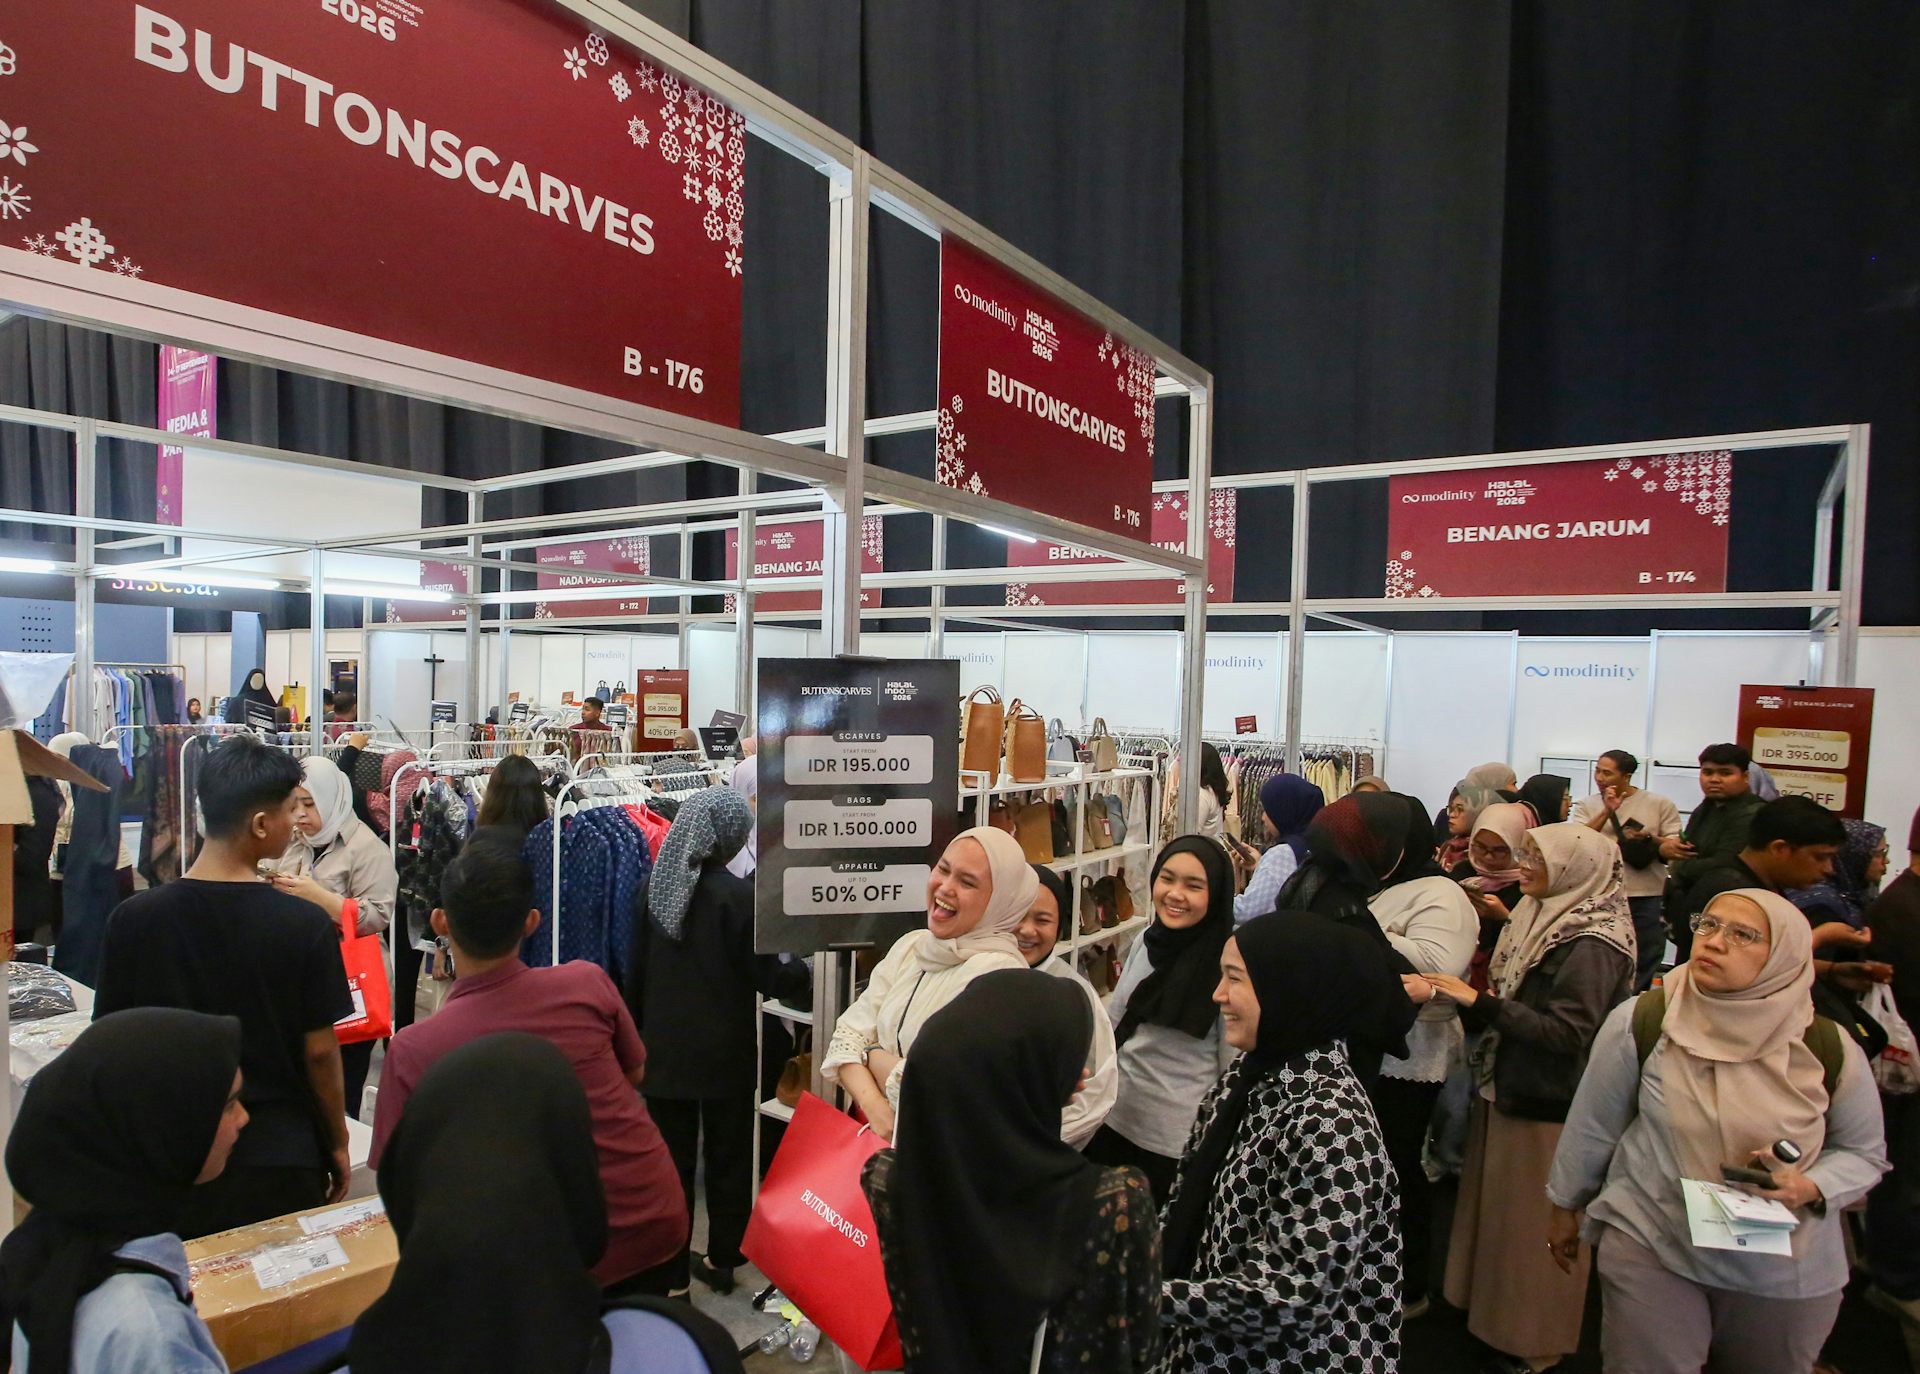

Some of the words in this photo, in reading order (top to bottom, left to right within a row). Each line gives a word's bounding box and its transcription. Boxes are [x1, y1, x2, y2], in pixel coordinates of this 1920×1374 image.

[321, 0, 397, 41] 2026
[403, 15, 419, 28] Expo
[134, 4, 656, 256] BUTTONSCARVES
[972, 294, 1018, 332] modinity
[1032, 341, 1053, 362] 2026
[623, 346, 645, 377] B
[665, 358, 705, 394] 176
[987, 368, 1126, 452] BUTTONSCARVES
[166, 411, 198, 433] MEDIA
[198, 408, 206, 426] &
[1421, 490, 1477, 501] modinity
[1497, 496, 1526, 506] 2026
[1114, 504, 1122, 522] B
[1126, 507, 1140, 527] 176
[1447, 523, 1550, 543] BENANG
[1555, 518, 1650, 539] JARUM
[754, 562, 803, 576] BENANG
[1638, 571, 1652, 583] B
[1666, 570, 1697, 583] 174
[559, 575, 584, 586] NADA
[1205, 656, 1265, 671] modinity
[1554, 663, 1638, 681] modinity
[801, 686, 872, 696] BUTTONSCARVES
[663, 729, 678, 737] OFF
[839, 732, 881, 740] SCARVES
[1761, 748, 1784, 758] IDR
[1786, 750, 1838, 762] 395.000
[808, 758, 837, 772] IDR
[842, 757, 910, 772] 195.000
[847, 796, 872, 804] BAGS
[799, 823, 828, 837] IDR
[833, 820, 917, 836] 1.500.000
[812, 885, 857, 903] 50%
[863, 884, 903, 901] OFF
[800, 1189, 869, 1249] BUTTONSCARVES
